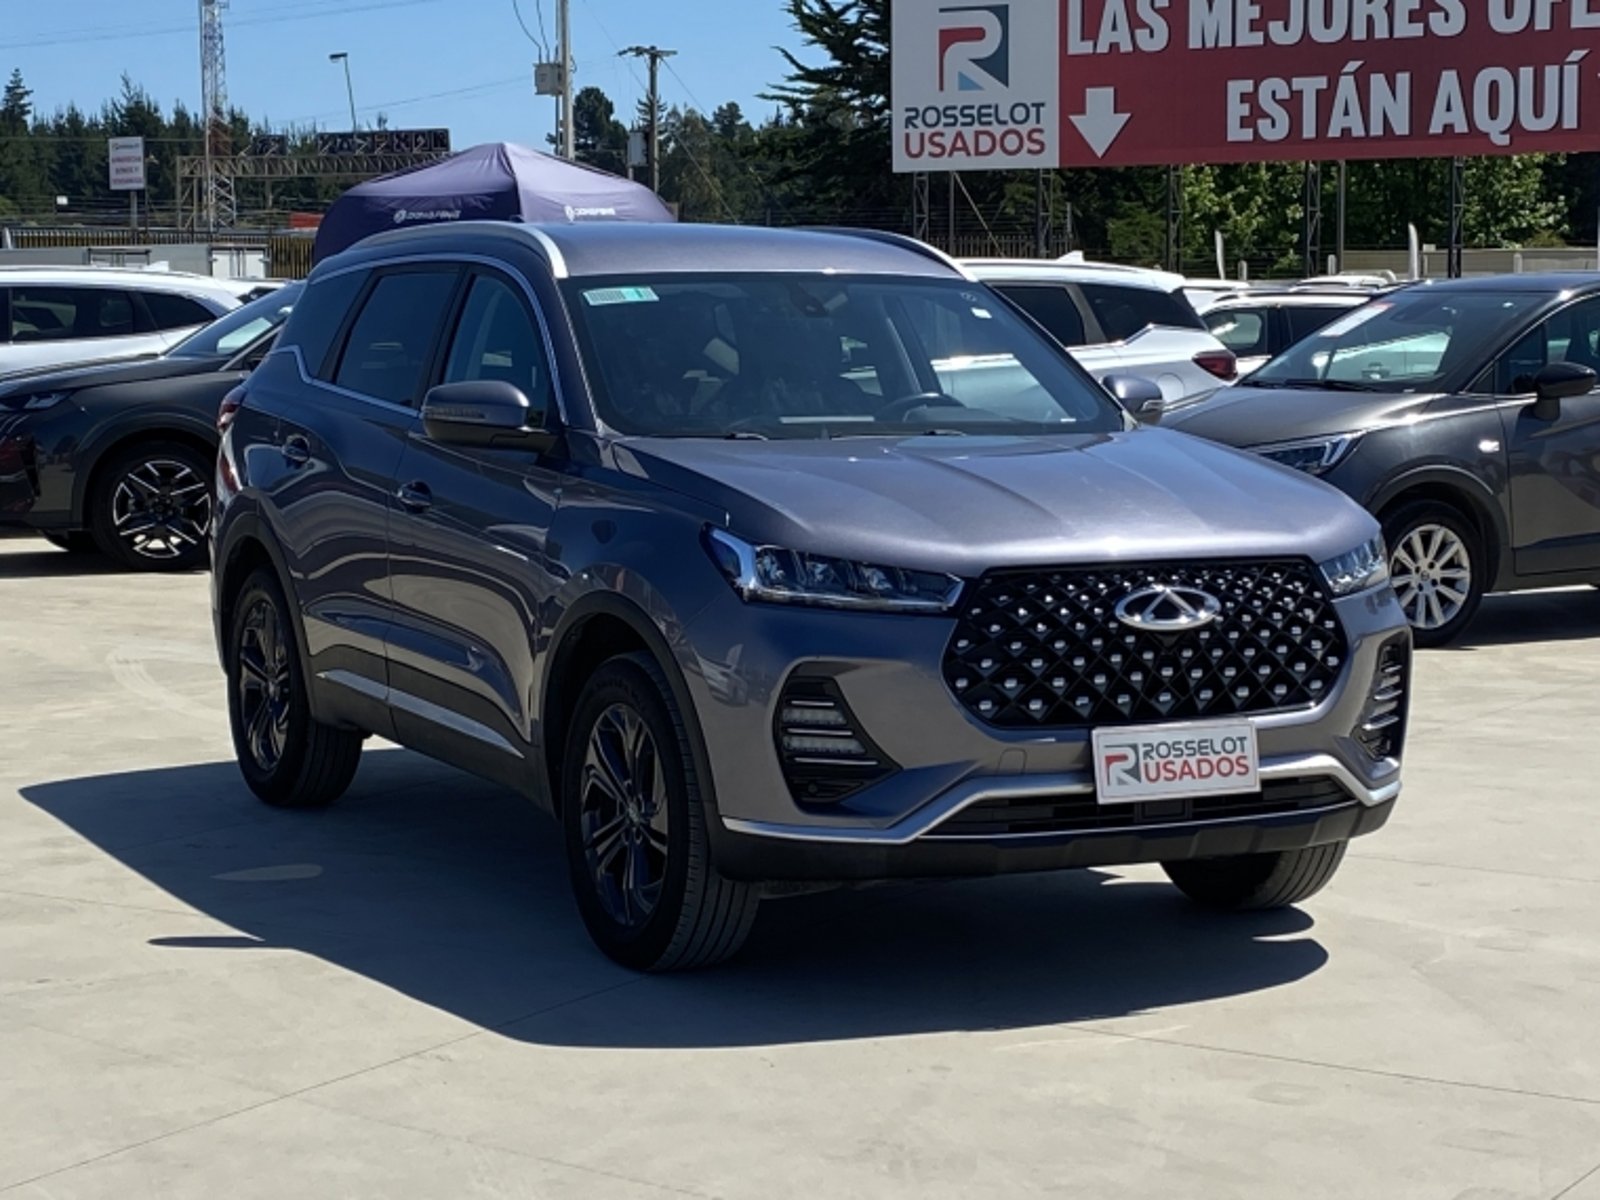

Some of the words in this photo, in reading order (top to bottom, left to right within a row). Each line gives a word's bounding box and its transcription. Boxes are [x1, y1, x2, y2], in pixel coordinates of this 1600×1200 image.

[1067, 0, 1170, 55] LAS
[1188, 0, 1466, 49] MEJORES
[1226, 60, 1411, 142] ESTÁN
[1428, 49, 1590, 146] AQUÍ
[904, 102, 1046, 129] ROSSELOT
[904, 128, 1046, 158] USADOS
[1142, 736, 1247, 760] ROSSELOT
[1143, 755, 1250, 783] USADOS
